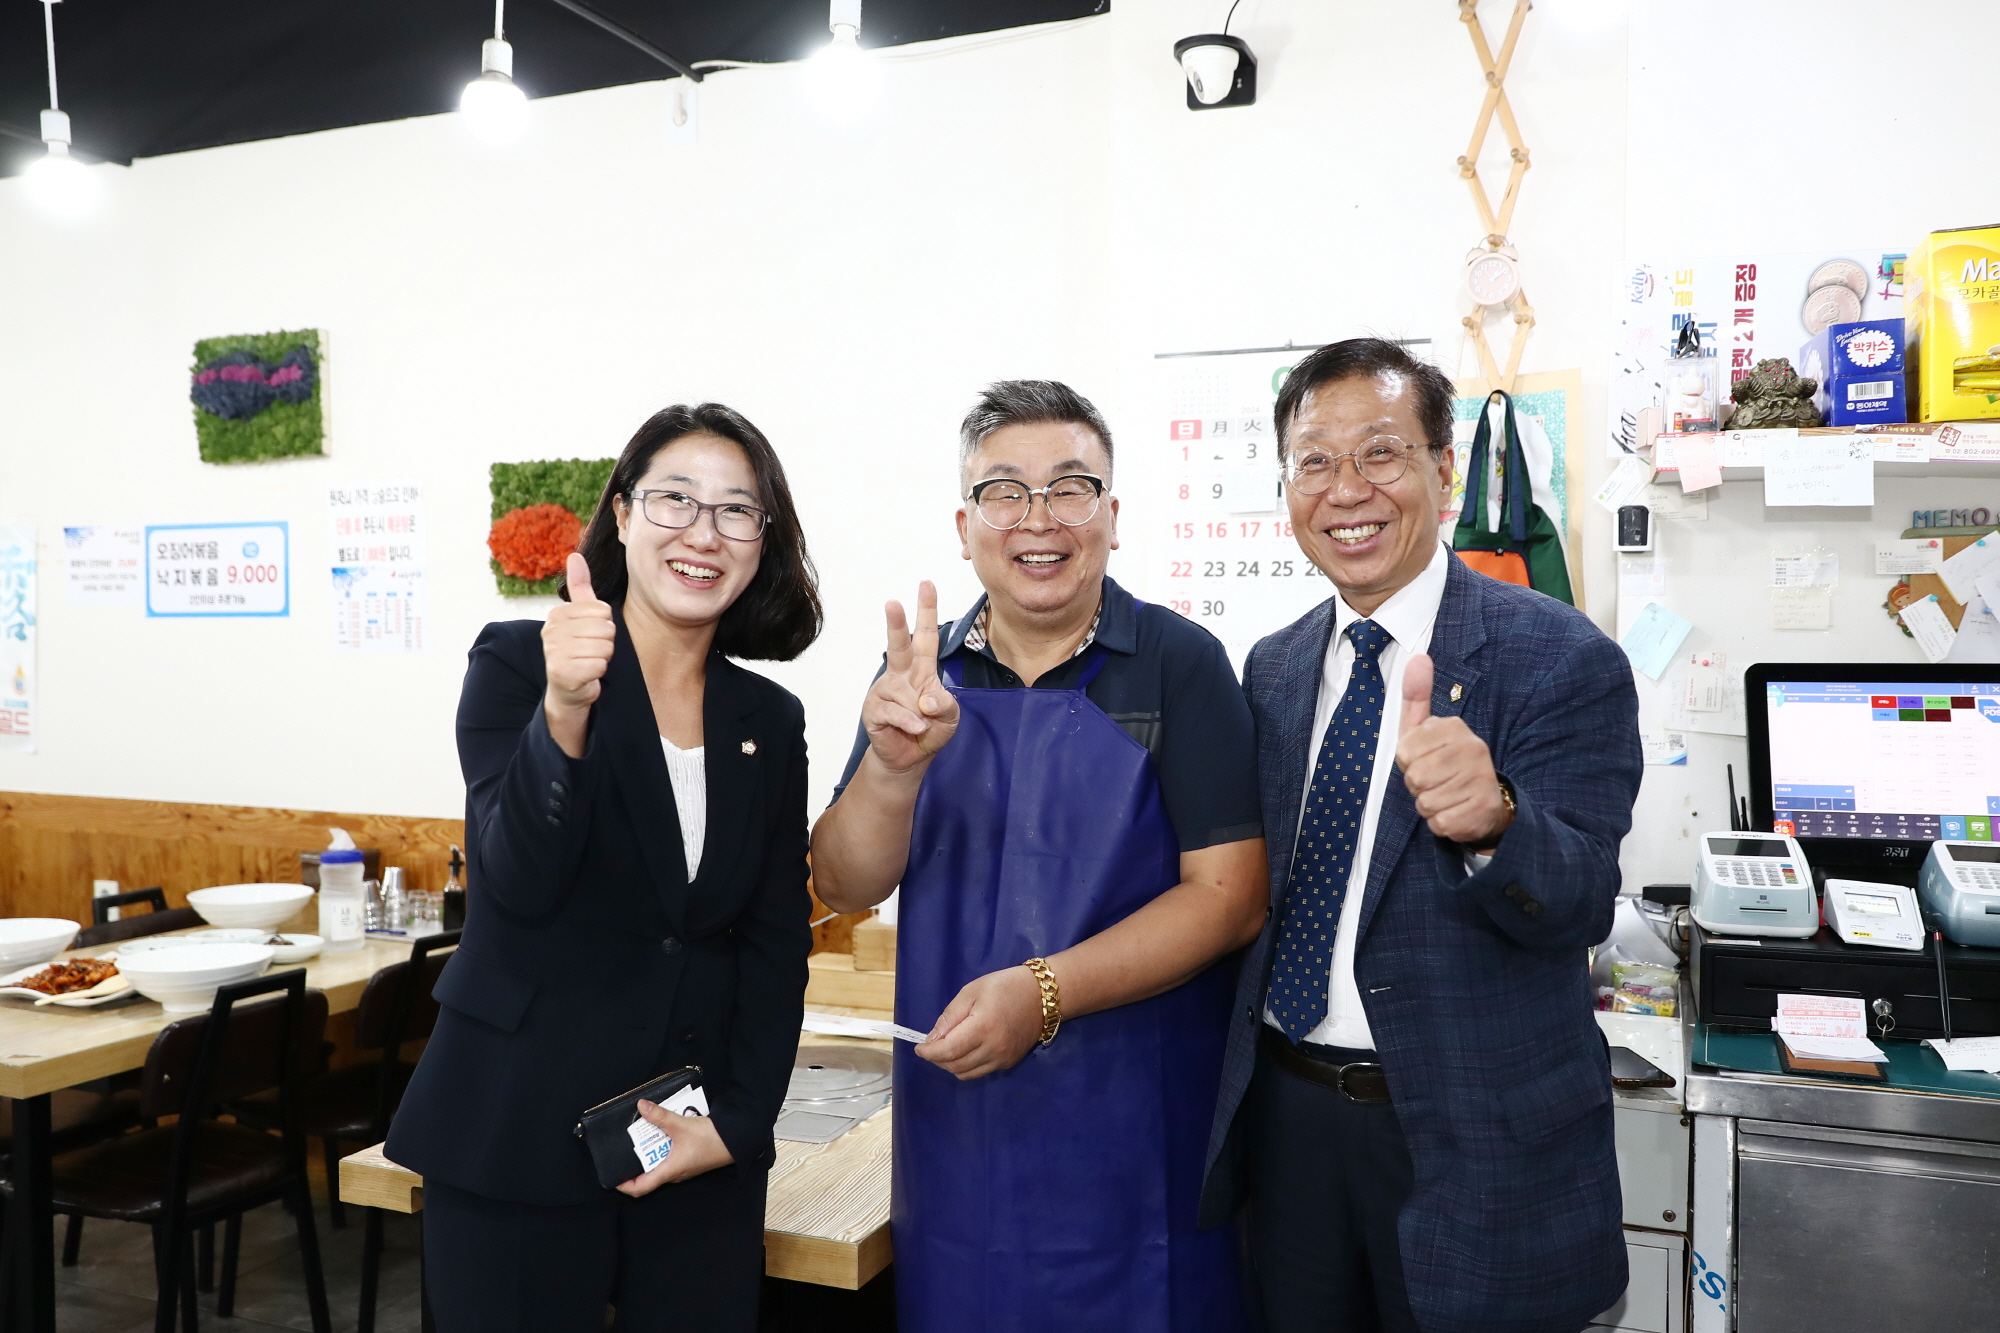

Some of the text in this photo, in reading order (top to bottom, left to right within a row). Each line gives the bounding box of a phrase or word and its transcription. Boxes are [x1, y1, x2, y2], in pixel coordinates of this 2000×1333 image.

[1631, 267, 1648, 304] Kelly
[1735, 263, 1756, 302] 증정
[1853, 340, 1889, 352] 박카스
[1868, 353, 1876, 363] F
[1241, 406, 1260, 415] 2024
[1856, 400, 1887, 409] 동아제약
[1178, 419, 1262, 436] 日 月 火
[1182, 443, 1257, 462] 1 3
[1179, 483, 1223, 500] 8 9
[1913, 507, 1990, 528] MEMO
[1173, 521, 1295, 538] 15 16 17 18
[157, 541, 219, 561] 오징어볶음
[1170, 562, 1193, 577] 22
[1203, 561, 1225, 577] 23
[1236, 561, 1260, 577] 24
[1271, 560, 1294, 577] 25
[1169, 600, 1225, 616] 29 30
